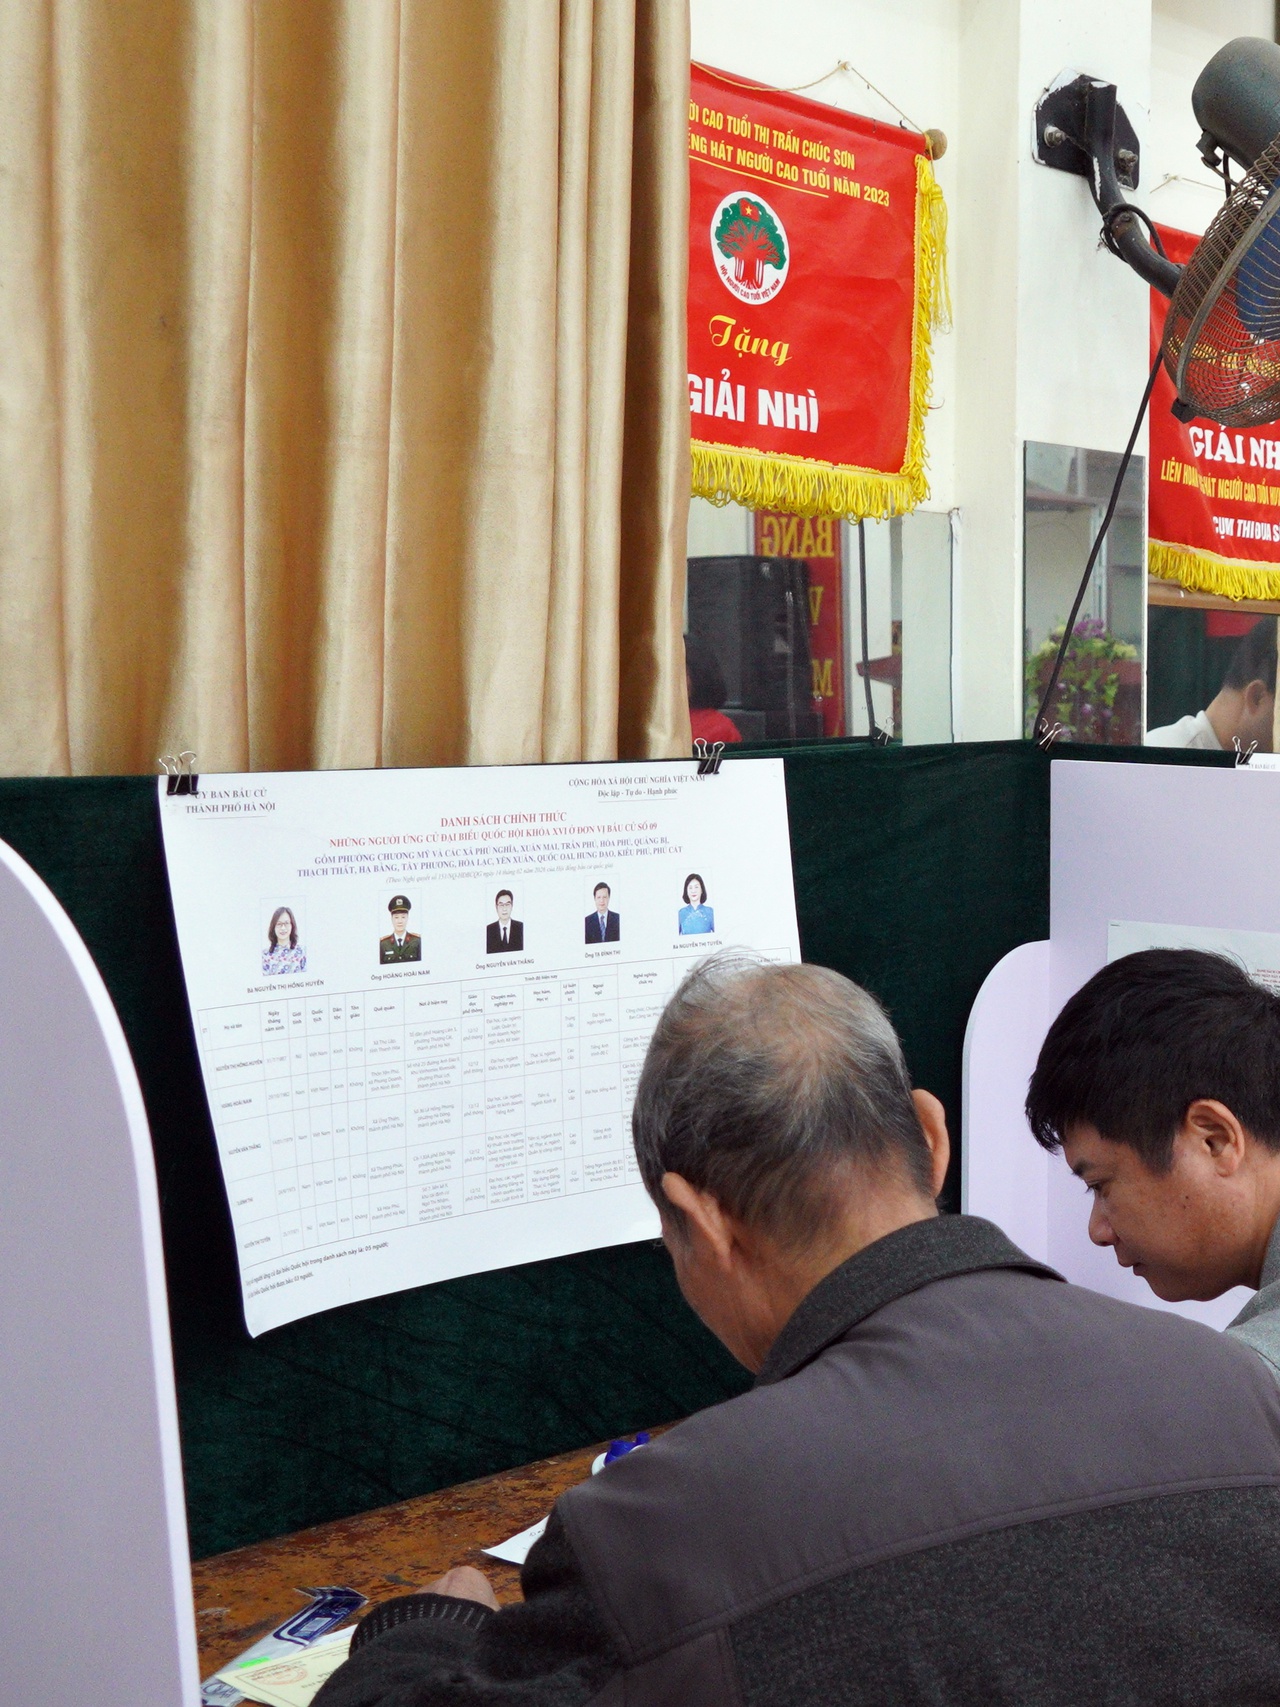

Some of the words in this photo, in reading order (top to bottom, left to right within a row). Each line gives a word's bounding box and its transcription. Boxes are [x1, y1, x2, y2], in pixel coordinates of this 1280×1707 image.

[702, 107, 724, 130] CAO
[727, 114, 751, 136] TUỔI
[754, 123, 770, 149] THỊ
[772, 128, 800, 155] TRẤN
[802, 138, 831, 163] CHÚC
[833, 148, 855, 171] SƠN
[710, 136, 732, 163] HÁT
[737, 146, 774, 175] NGƯỜI
[776, 159, 799, 182] CAO
[802, 167, 830, 191] TUỔI
[833, 174, 861, 199] NĂM
[863, 185, 890, 207] 2023
[708, 314, 793, 367] Tặng
[687, 368, 746, 423] GIẢI
[758, 388, 819, 434] NHÌ
[1189, 424, 1246, 465] GIẢI
[1161, 456, 1183, 484] LIÊN
[1218, 476, 1243, 501] NGƯỜI
[1243, 482, 1257, 503] CAO
[1212, 516, 1235, 539] CỤM
[1237, 519, 1254, 539] THI
[1254, 521, 1272, 541] ĐUA
[568, 778, 589, 787] CỘNG
[608, 776, 618, 785] XÃ
[619, 776, 633, 785] HỘI
[650, 774, 671, 784] NGHĨA
[672, 774, 689, 784] VIỆT
[690, 774, 706, 782] NAM
[210, 790, 230, 799] BAN
[232, 787, 252, 798] BẦU
[254, 788, 267, 798] CỬ
[185, 803, 219, 814] THÀNH
[222, 802, 242, 812] PHỐ
[244, 801, 257, 811] HÀ
[259, 801, 276, 812] NỘI
[440, 816, 470, 827] DANH
[473, 813, 501, 826] SÁCH
[504, 811, 536, 824] CHÍNH
[538, 809, 568, 823] THỨC
[329, 836, 366, 848] NHỮNG
[368, 834, 400, 846] NGƯỜI
[403, 832, 424, 844] ỨNG
[425, 831, 440, 843] CỬ
[440, 832, 456, 843] ĐẠI
[458, 829, 479, 841] BIỂU
[481, 827, 506, 840] QUỐC
[508, 828, 524, 839] HỘI
[526, 826, 550, 837] KHÓA
[552, 826, 567, 836] XVI
[577, 825, 595, 835] ĐƠN
[597, 825, 605, 835] VỊ
[607, 822, 622, 833] BẦU
[624, 821, 637, 832] CỬ
[638, 819, 649, 831] SỐ
[649, 822, 658, 830] 09
[314, 853, 336, 865] GỒM
[338, 853, 376, 863] PHƯỜNG
[377, 851, 415, 862] CHƯƠNG
[417, 849, 431, 860] MỸ
[432, 849, 443, 858] VÀ
[444, 848, 461, 857] CÁC
[462, 847, 474, 856] XÃ
[297, 866, 329, 878] THẠCH
[359, 865, 372, 875] HẠ
[401, 861, 420, 872] TÂY
[486, 960, 506, 969] NGUYỄN
[382, 971, 402, 979] HOÀNG
[254, 983, 277, 993] NGUYỄN
